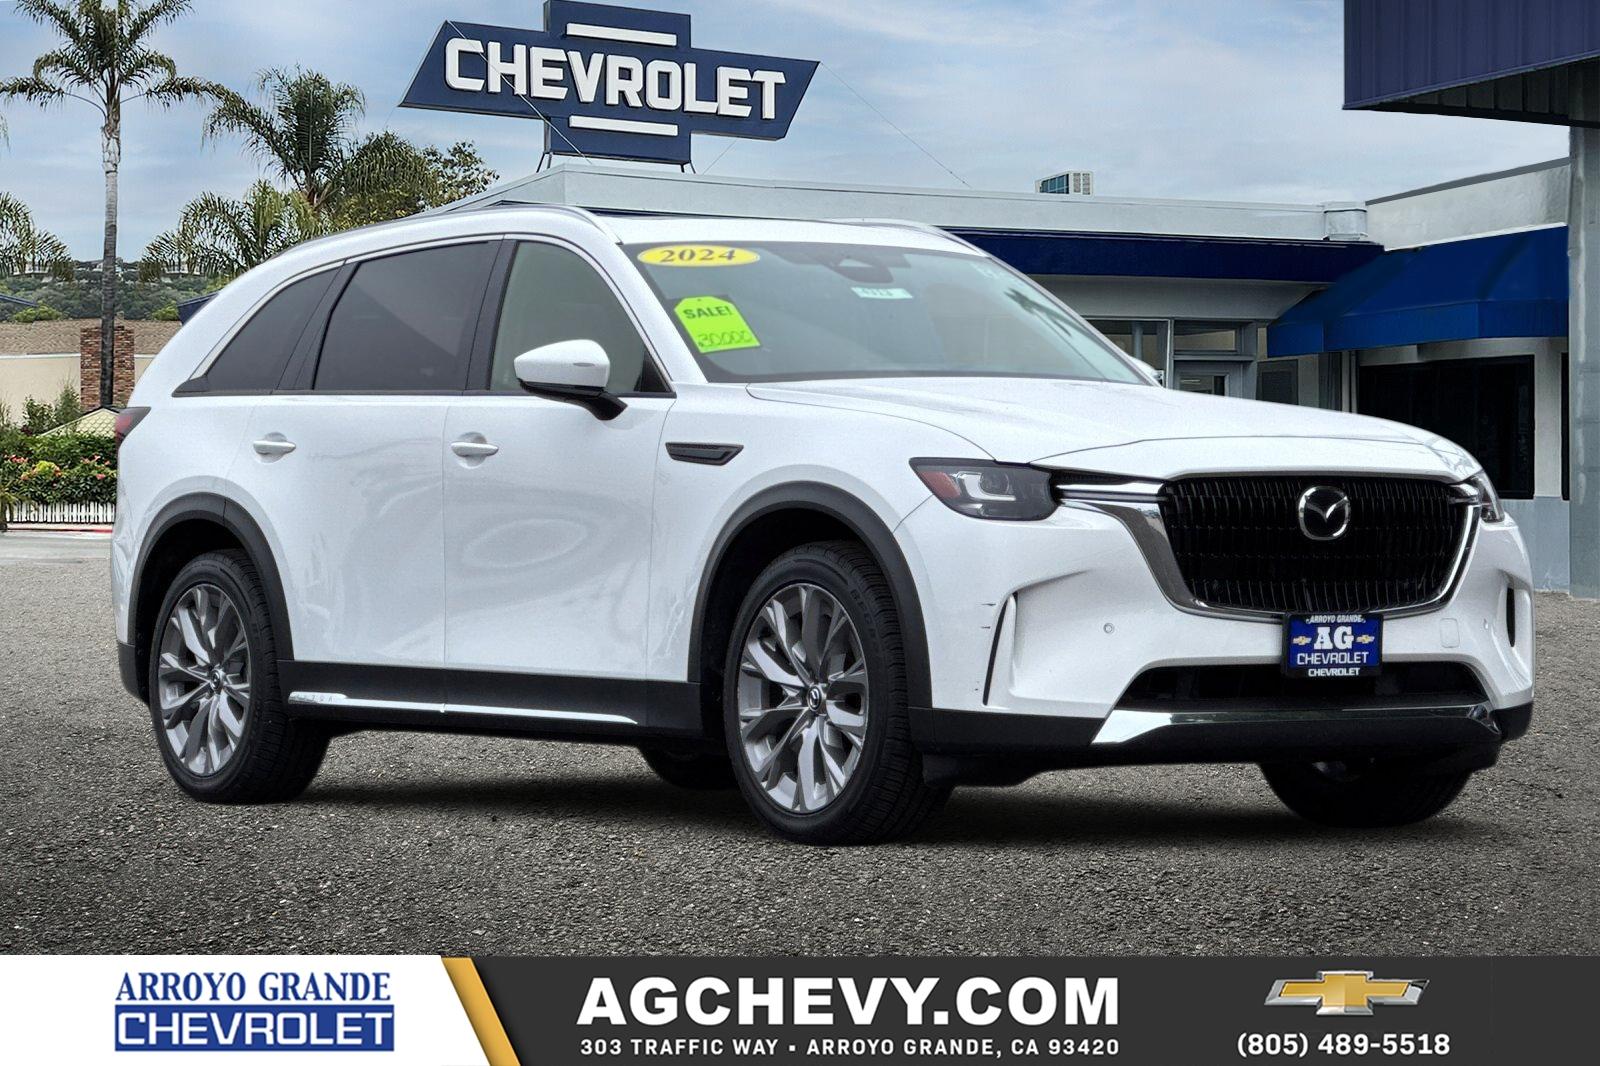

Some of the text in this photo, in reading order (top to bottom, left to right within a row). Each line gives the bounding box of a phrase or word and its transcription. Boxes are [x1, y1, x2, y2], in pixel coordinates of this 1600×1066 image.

[445, 38, 786, 119] CHEVROLET
[660, 248, 736, 263] 2024
[683, 305, 735, 319] SALE!
[1310, 615, 1362, 623] ARROYO GRANDE
[1314, 626, 1354, 649] AG
[1297, 652, 1369, 665] CHEVROLET
[1308, 667, 1361, 677] CHEVROLET
